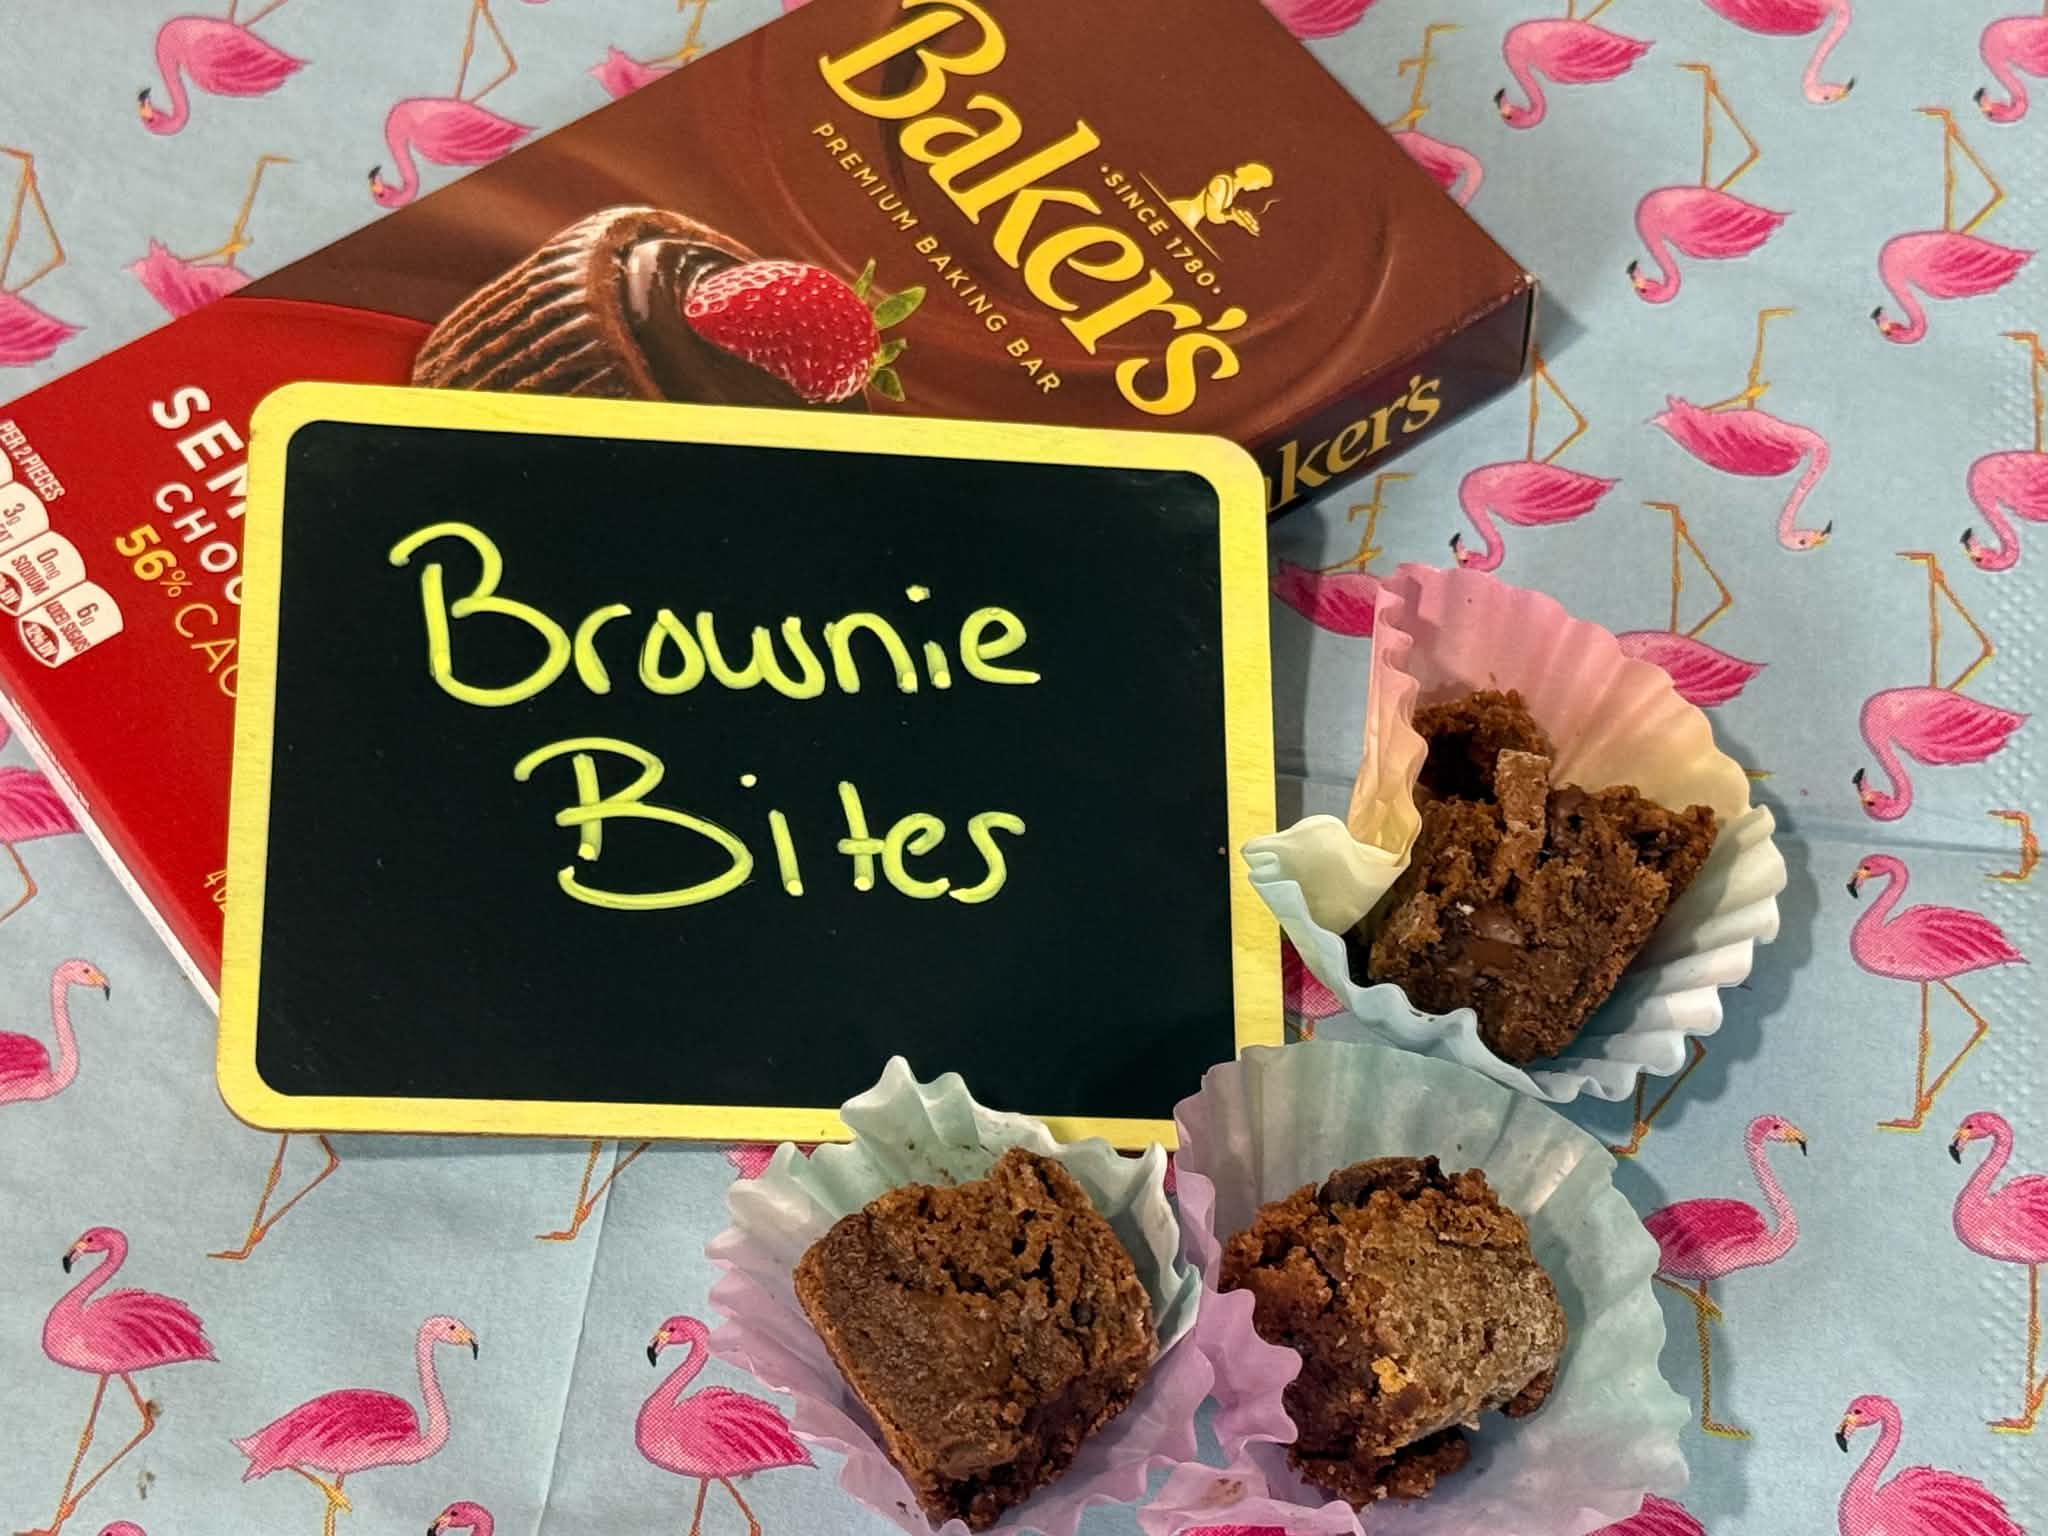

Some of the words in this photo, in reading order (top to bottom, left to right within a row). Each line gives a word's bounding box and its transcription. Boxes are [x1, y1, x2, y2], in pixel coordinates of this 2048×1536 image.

[819, 0, 1248, 415] Baker's
[1104, 173, 1169, 236] SINCE
[1165, 237, 1215, 286] 1780
[812, 123, 919, 232] PREMIUM
[915, 236, 1006, 333] BAKING
[1006, 338, 1062, 394] BAR
[0, 419, 27, 451] PER
[12, 444, 33, 460] 2
[19, 453, 66, 501] PIECES
[1264, 375, 1441, 513] ker's
[11, 554, 50, 596] SODIUM
[115, 524, 193, 598] 56%
[60, 622, 91, 653] SUGARS
[389, 521, 1041, 707] Brownie
[513, 736, 1026, 910] Bites
